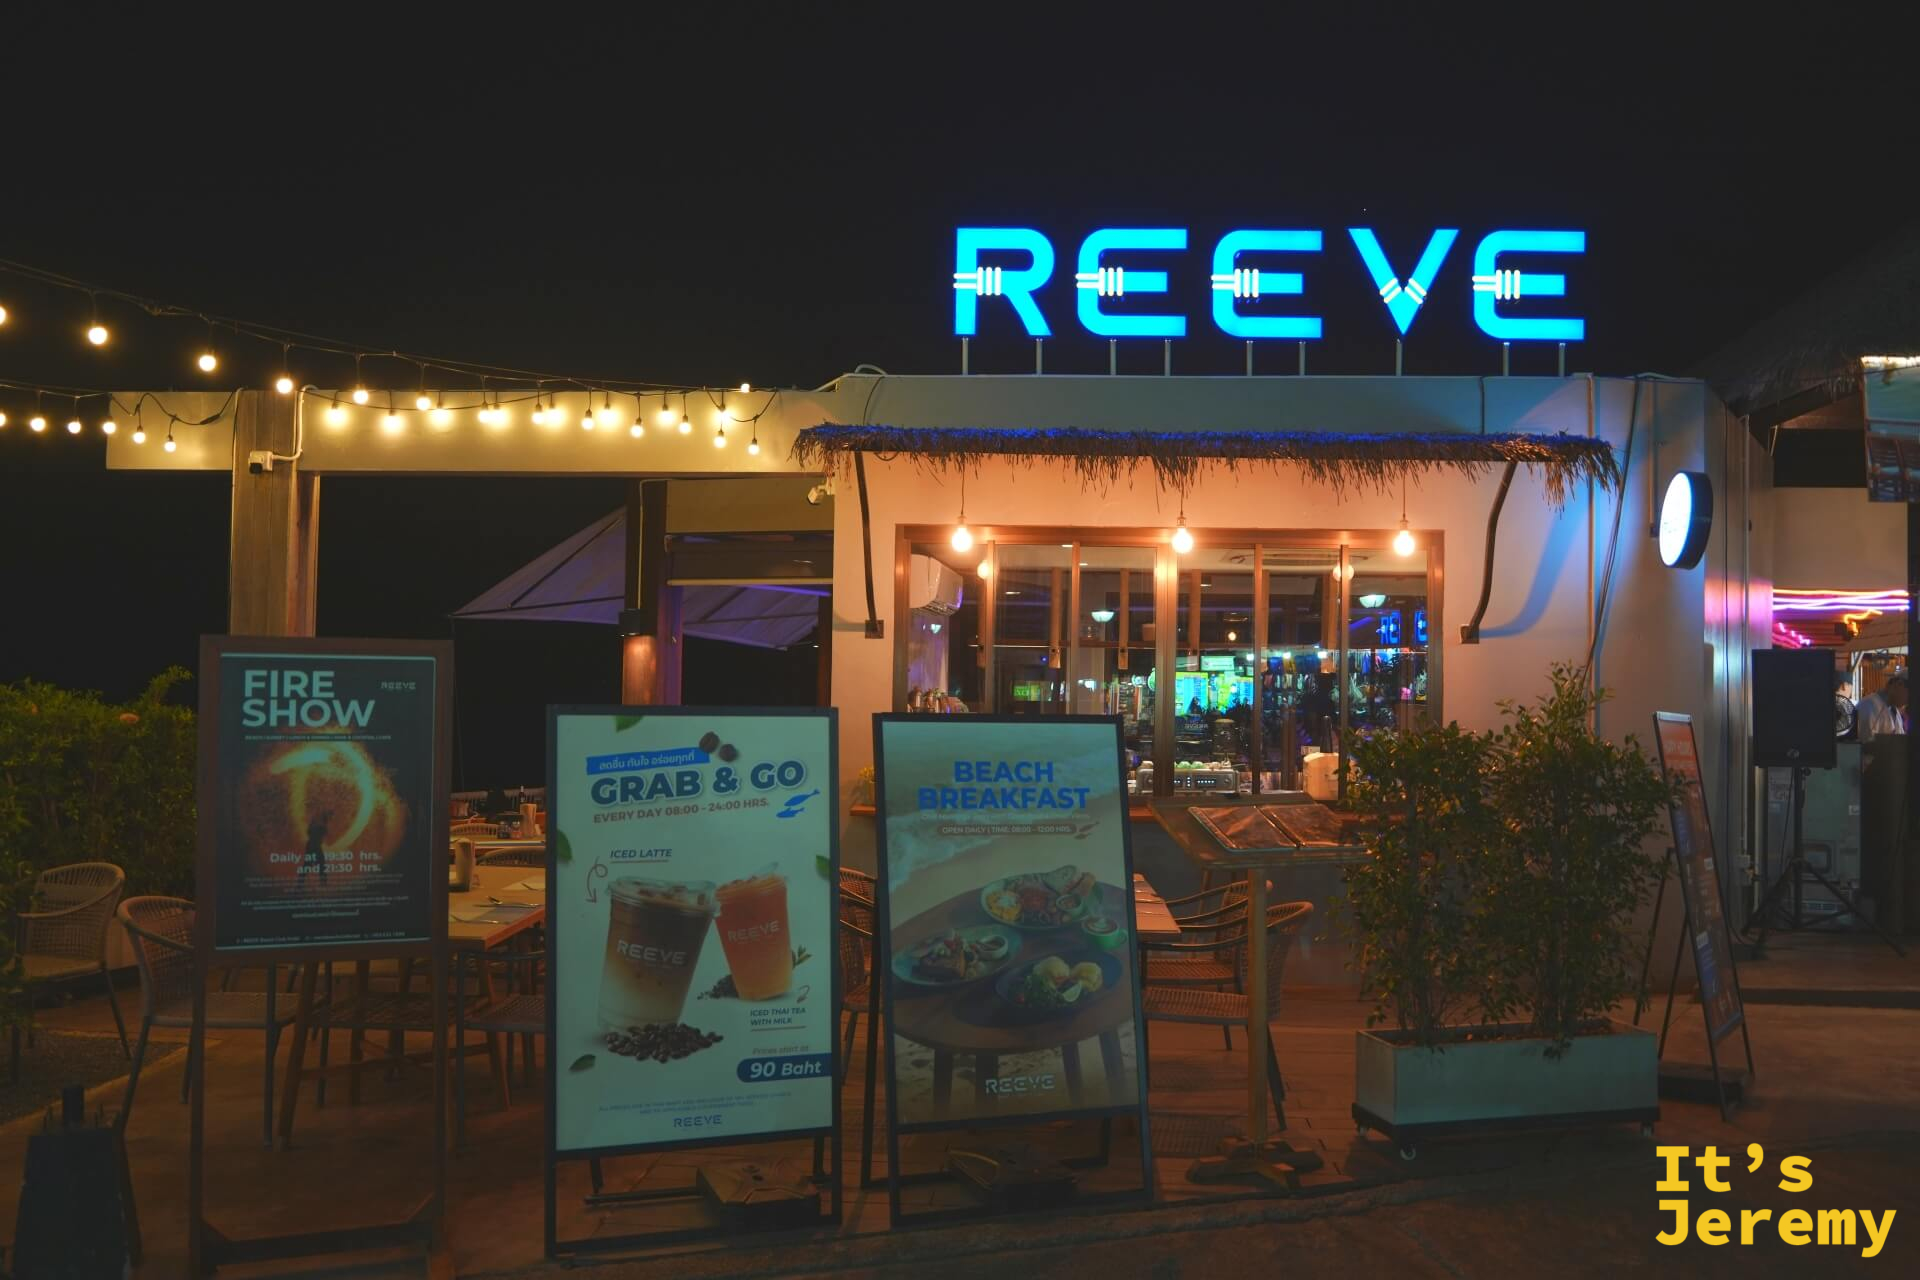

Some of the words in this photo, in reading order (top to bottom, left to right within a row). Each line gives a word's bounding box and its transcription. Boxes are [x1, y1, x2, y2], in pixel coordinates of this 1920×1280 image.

[953, 227, 1587, 341] REEVE
[243, 669, 336, 699] FIRE
[380, 680, 417, 692] REEVE
[241, 699, 375, 728] SHOW
[953, 760, 1054, 783] BEACH
[591, 768, 702, 806] GRAB
[712, 765, 739, 795] &
[750, 759, 806, 790] GO
[917, 787, 1090, 810] BREAKFAST
[593, 808, 634, 824] EVERY
[637, 807, 663, 820] DAY
[664, 804, 700, 817] 08:00
[708, 800, 742, 813] 24:00
[941, 825, 964, 835] OPEN
[965, 825, 986, 835] DAILY
[269, 851, 301, 865] Daily
[304, 852, 317, 862] at
[323, 850, 353, 861] 19:30
[359, 850, 383, 861] hrs.
[609, 848, 637, 859] ICED
[639, 848, 673, 859] LATTE
[296, 863, 320, 874] and
[323, 862, 353, 874] 21:30
[359, 861, 382, 873] hrs.
[726, 919, 782, 943] REEVE
[615, 938, 688, 967] REEVE
[750, 1007, 770, 1018] ICED
[771, 1006, 790, 1017] THAI
[791, 1005, 807, 1016] TEA
[750, 1017, 771, 1027] WITH
[773, 1016, 793, 1026] MILK
[752, 1046, 778, 1056] Prices
[779, 1045, 800, 1055] start
[749, 1060, 777, 1079] 90
[781, 1059, 823, 1077] Baht
[984, 1074, 1057, 1096] REEVE
[672, 1113, 724, 1129] REEVE
